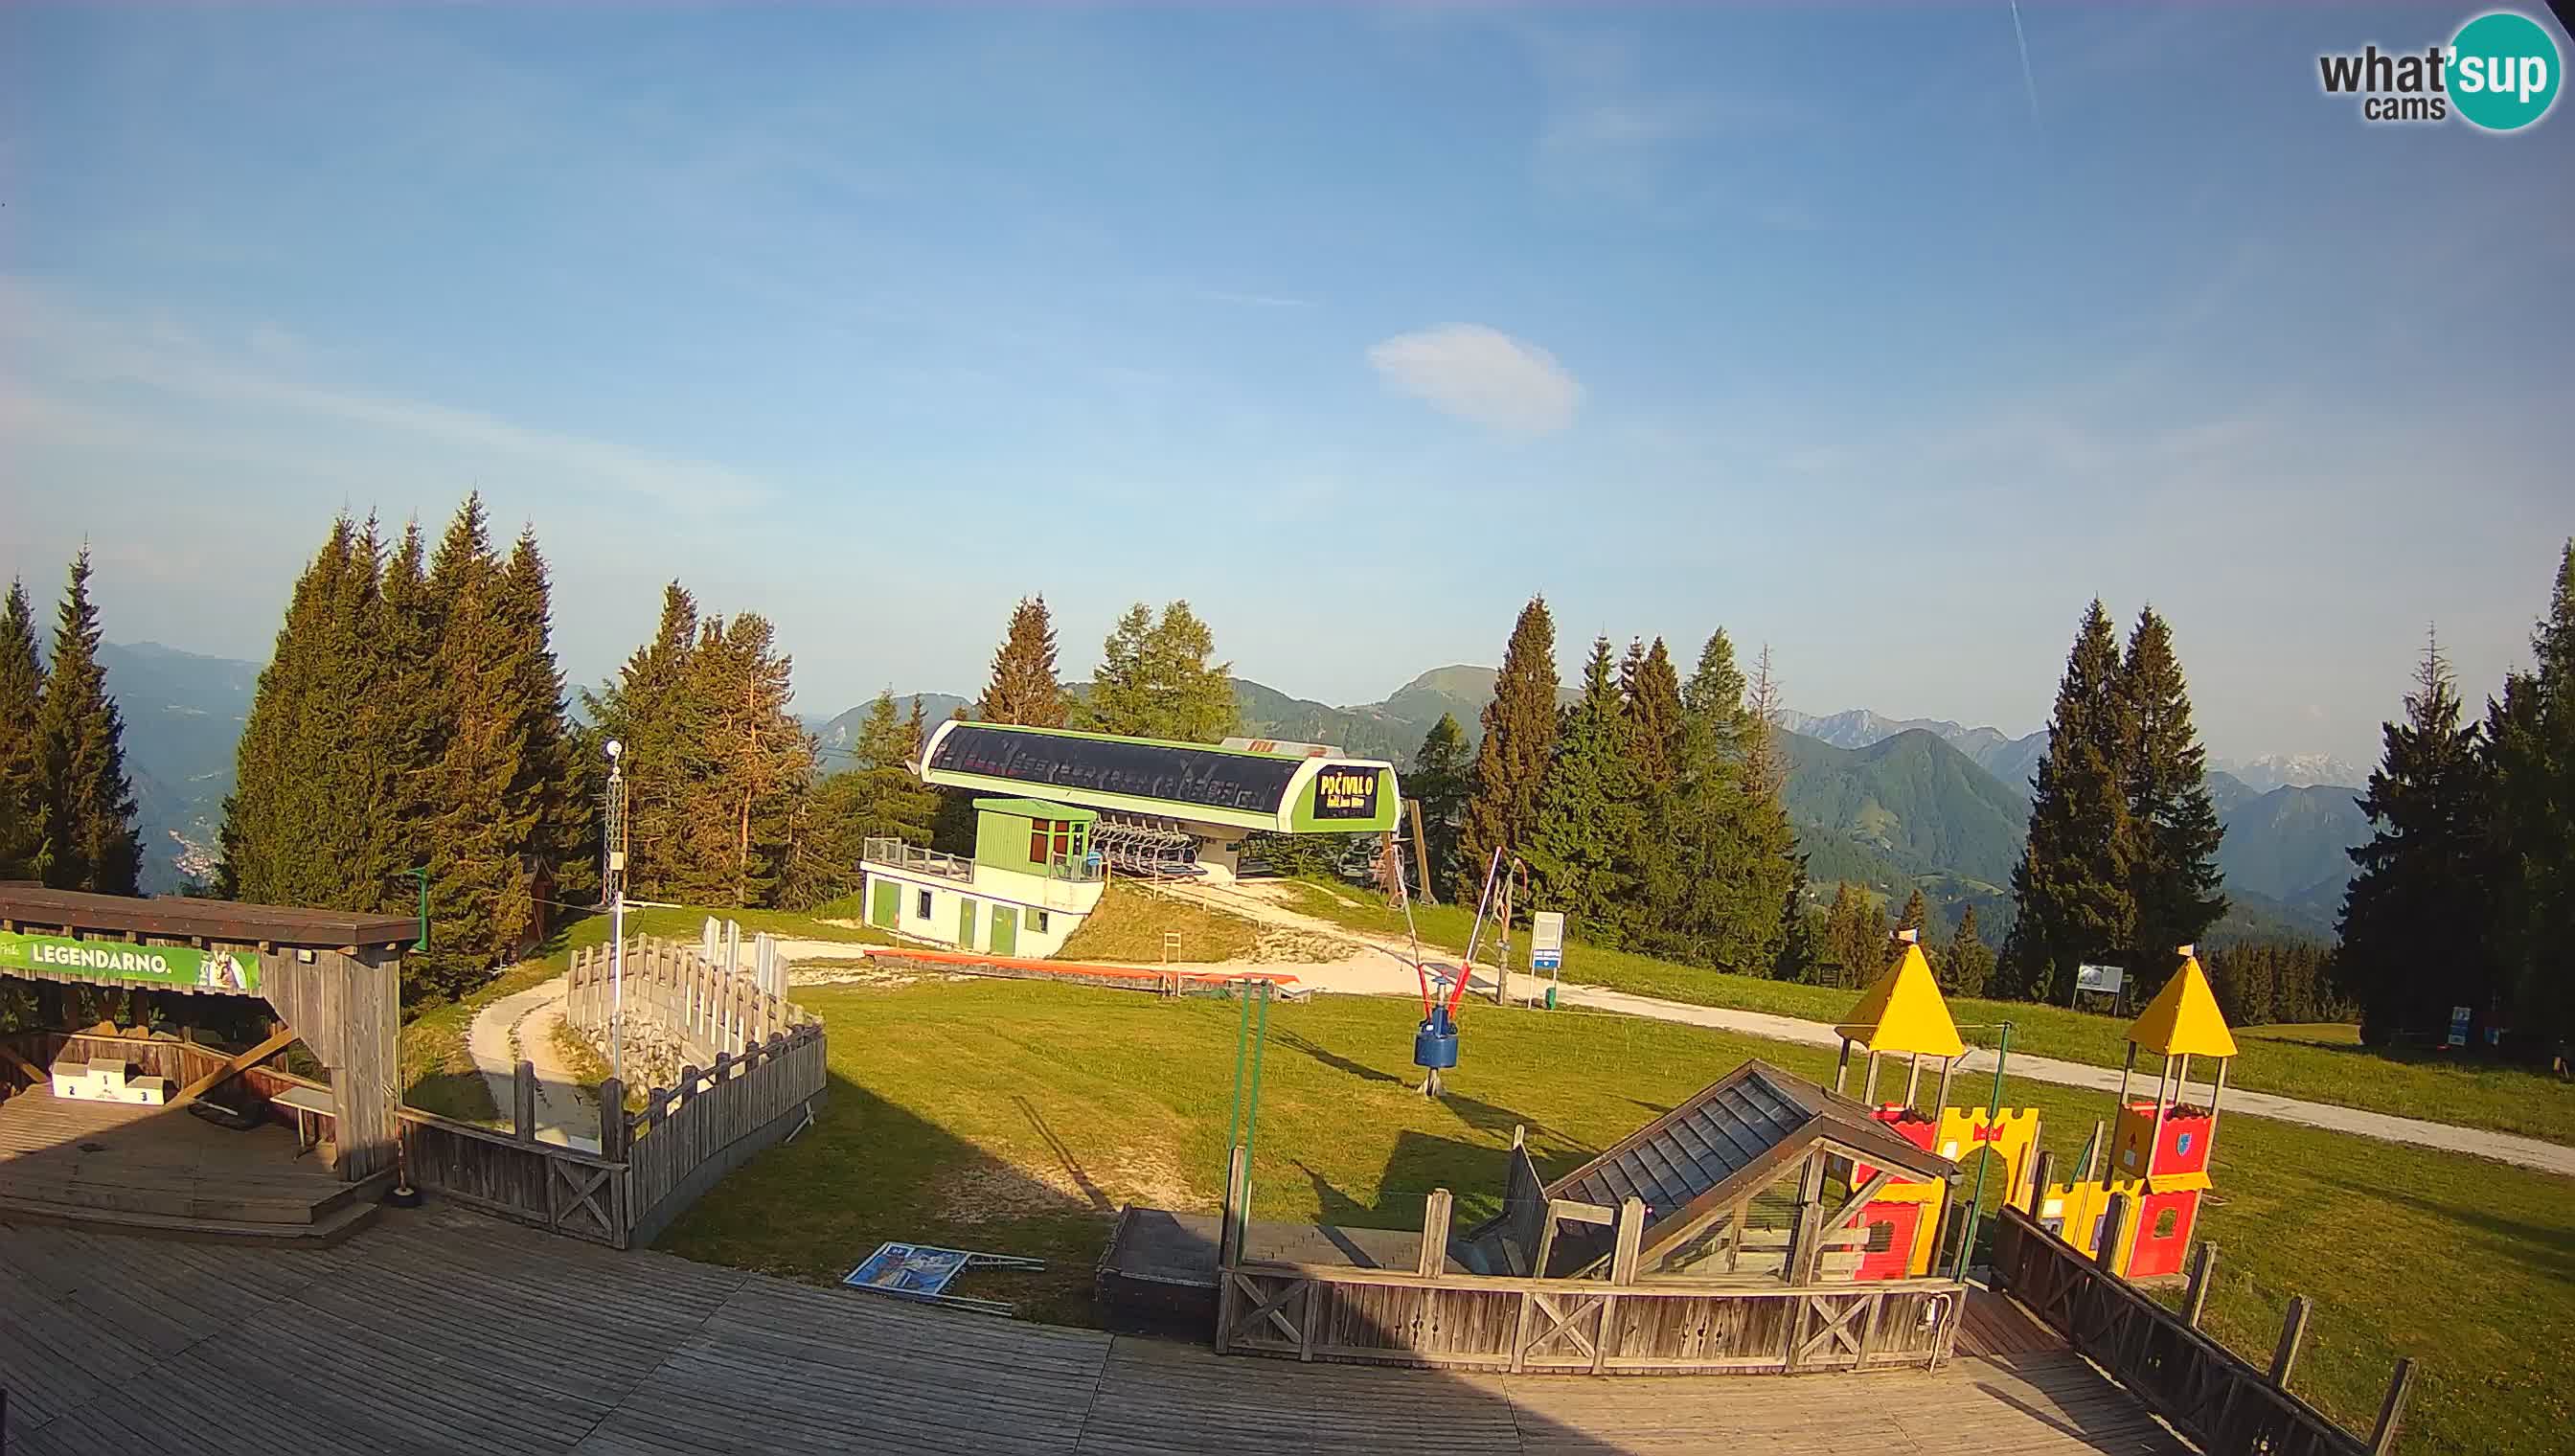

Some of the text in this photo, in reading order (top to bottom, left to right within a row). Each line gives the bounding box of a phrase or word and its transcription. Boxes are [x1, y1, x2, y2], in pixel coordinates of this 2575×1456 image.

[33, 943, 172, 974] LEGENDARNO.
[68, 1085, 75, 1096] 2
[140, 1091, 148, 1102] 3
